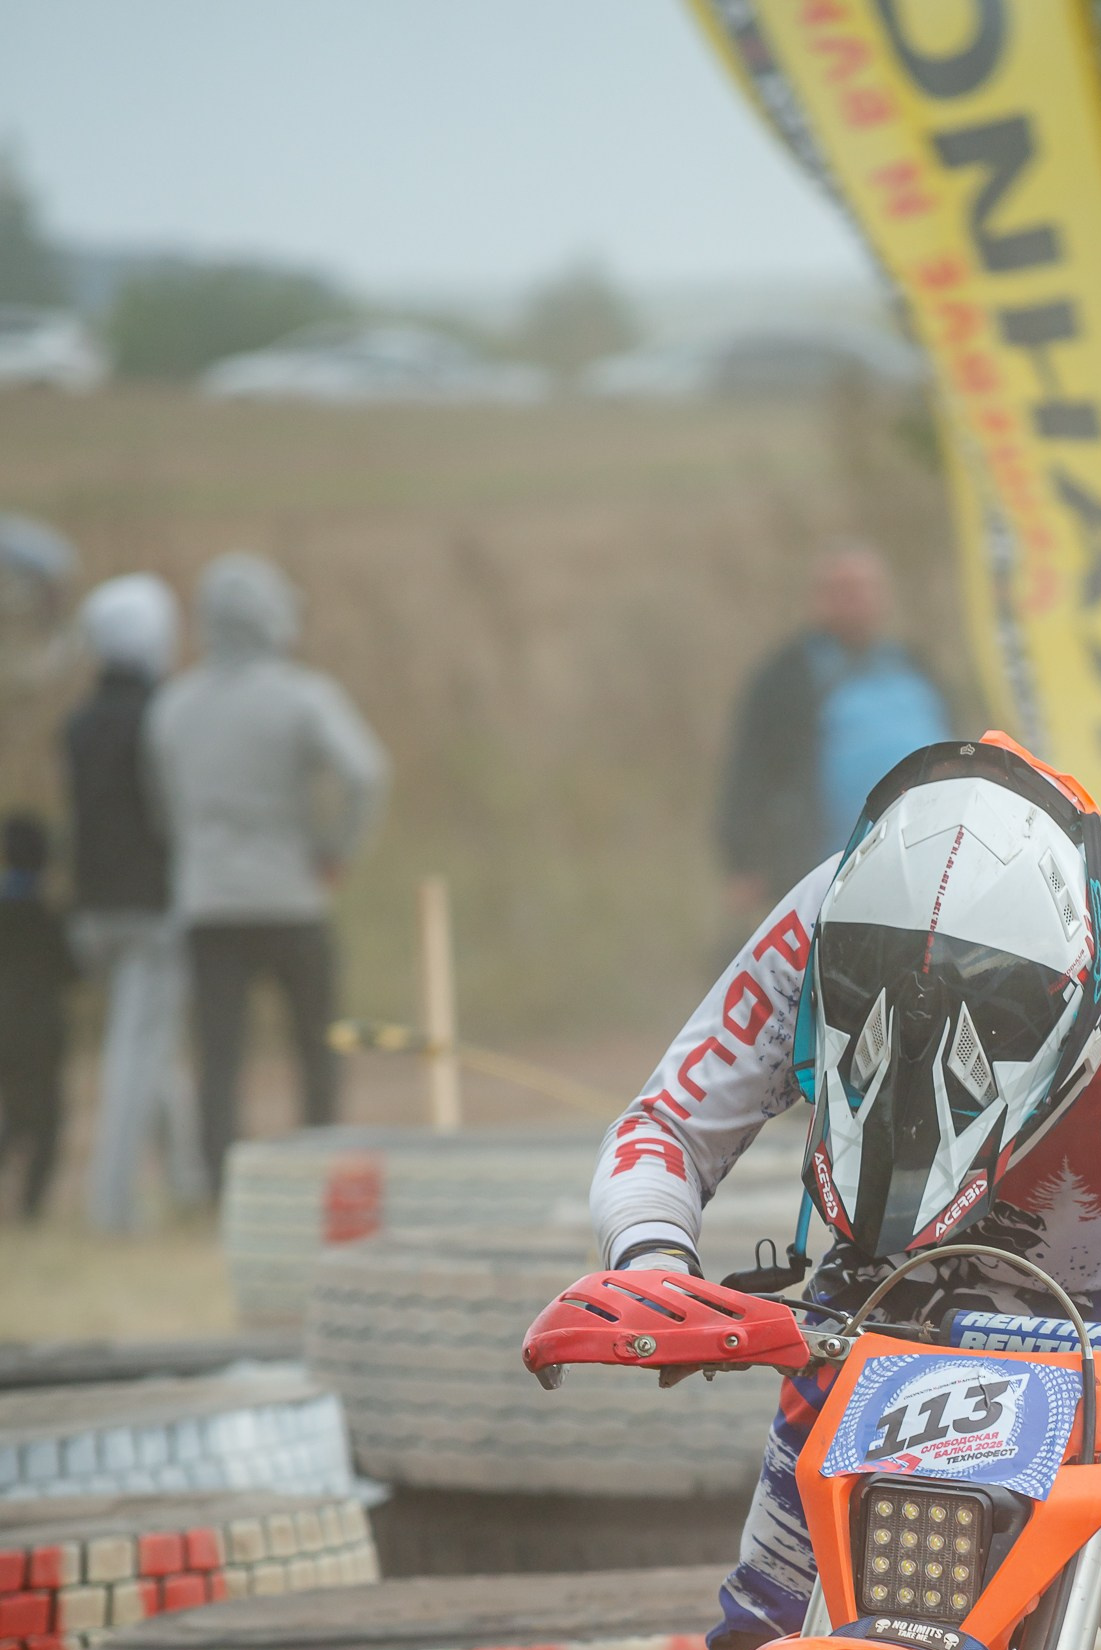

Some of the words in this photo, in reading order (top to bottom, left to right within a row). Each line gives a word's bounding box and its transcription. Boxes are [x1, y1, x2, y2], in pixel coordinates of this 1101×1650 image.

[864, 1379, 1011, 1462] 113
[920, 1431, 1000, 1454] СЛОБОДСКАЯ
[933, 1444, 973, 1460] БАЛКА
[973, 1440, 1004, 1452] 2025
[946, 1448, 1016, 1465] ТЕХНОФЕСТ
[892, 1620, 908, 1630] NO
[908, 1623, 944, 1639] LIMITS
